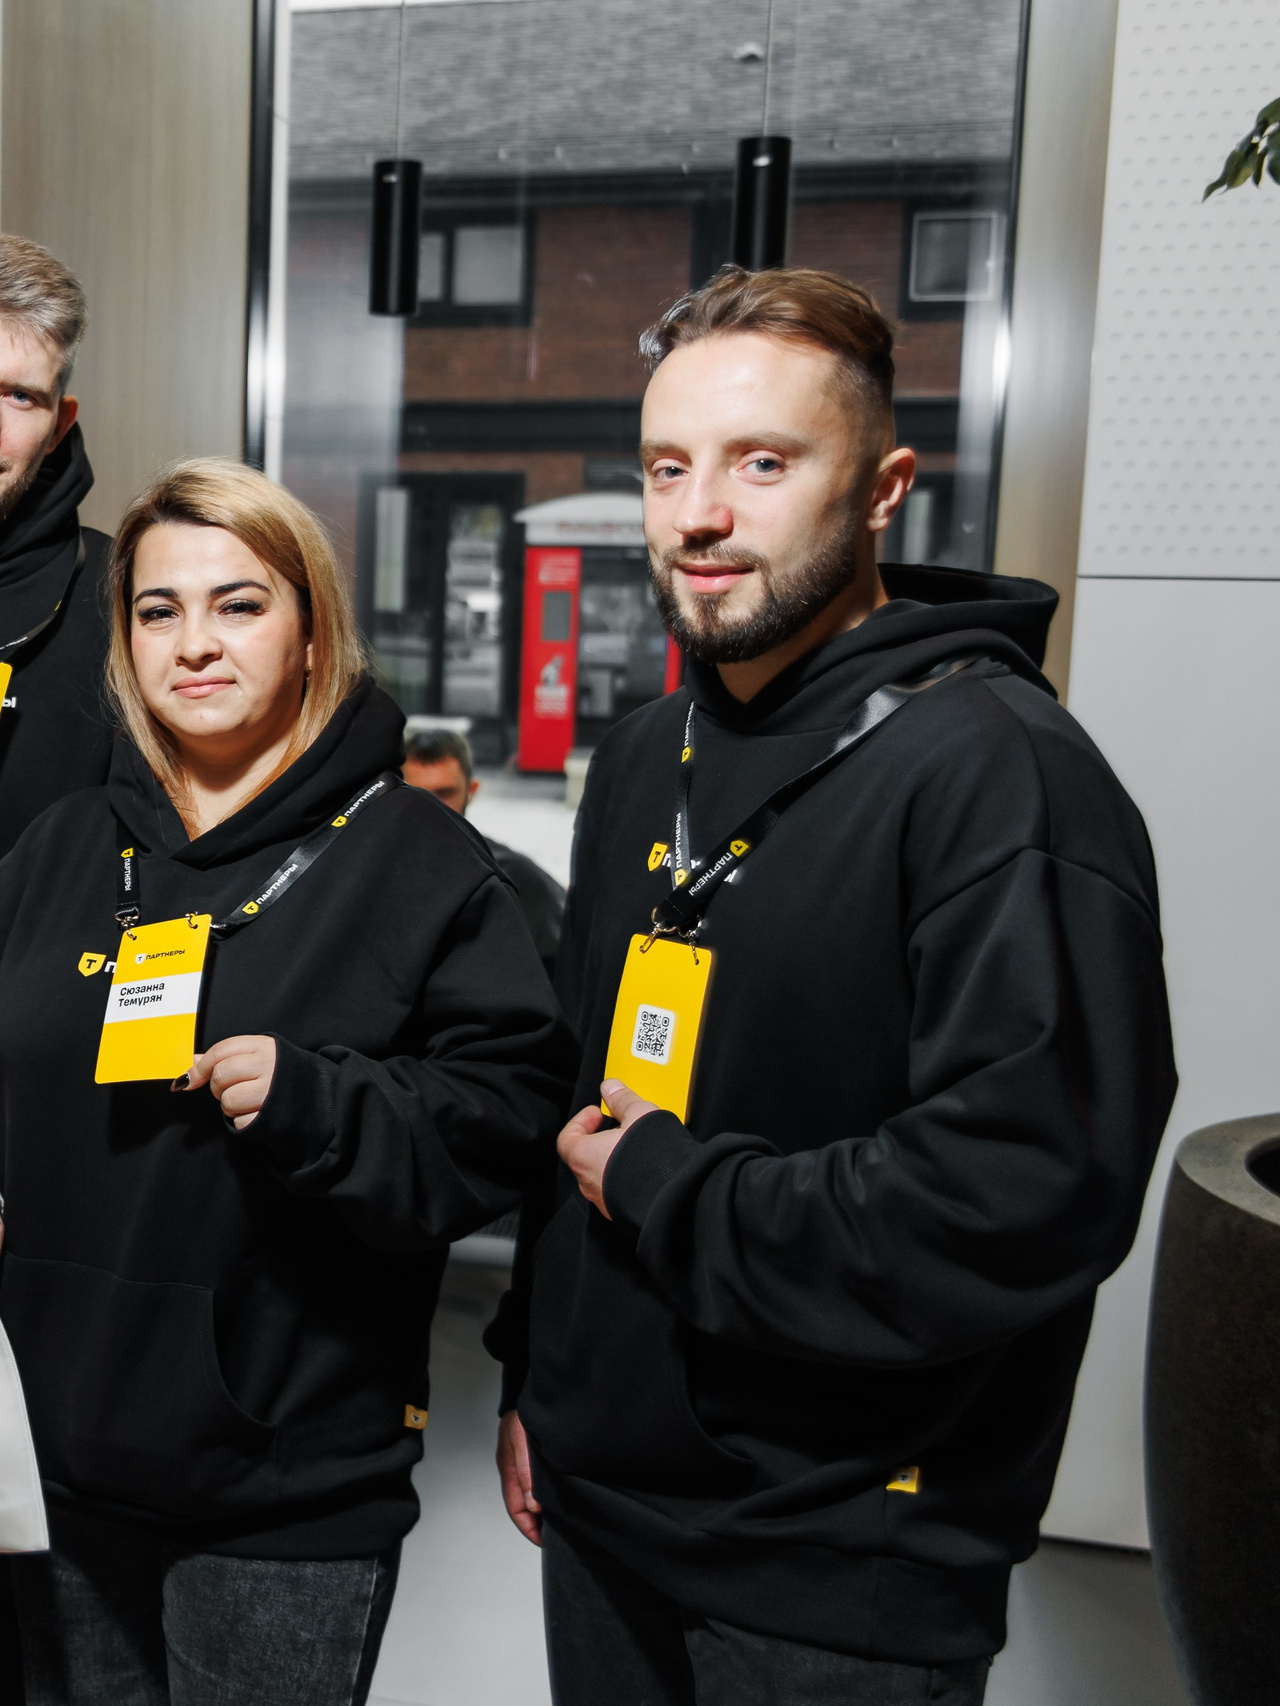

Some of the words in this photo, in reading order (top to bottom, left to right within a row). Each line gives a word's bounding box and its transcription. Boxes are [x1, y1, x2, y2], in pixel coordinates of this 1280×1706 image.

[344, 780, 386, 816] ПАРТНЕРЫ
[124, 858, 132, 892] ПАРТНЕРЫ
[256, 863, 298, 904] ПАРТНЕРЫ
[688, 852, 733, 896] ПАРТНЕРЫ
[146, 949, 186, 960] ПАРТНЕРЫ
[118, 993, 162, 1008] Темурян
[120, 982, 165, 996] Сюзанна
